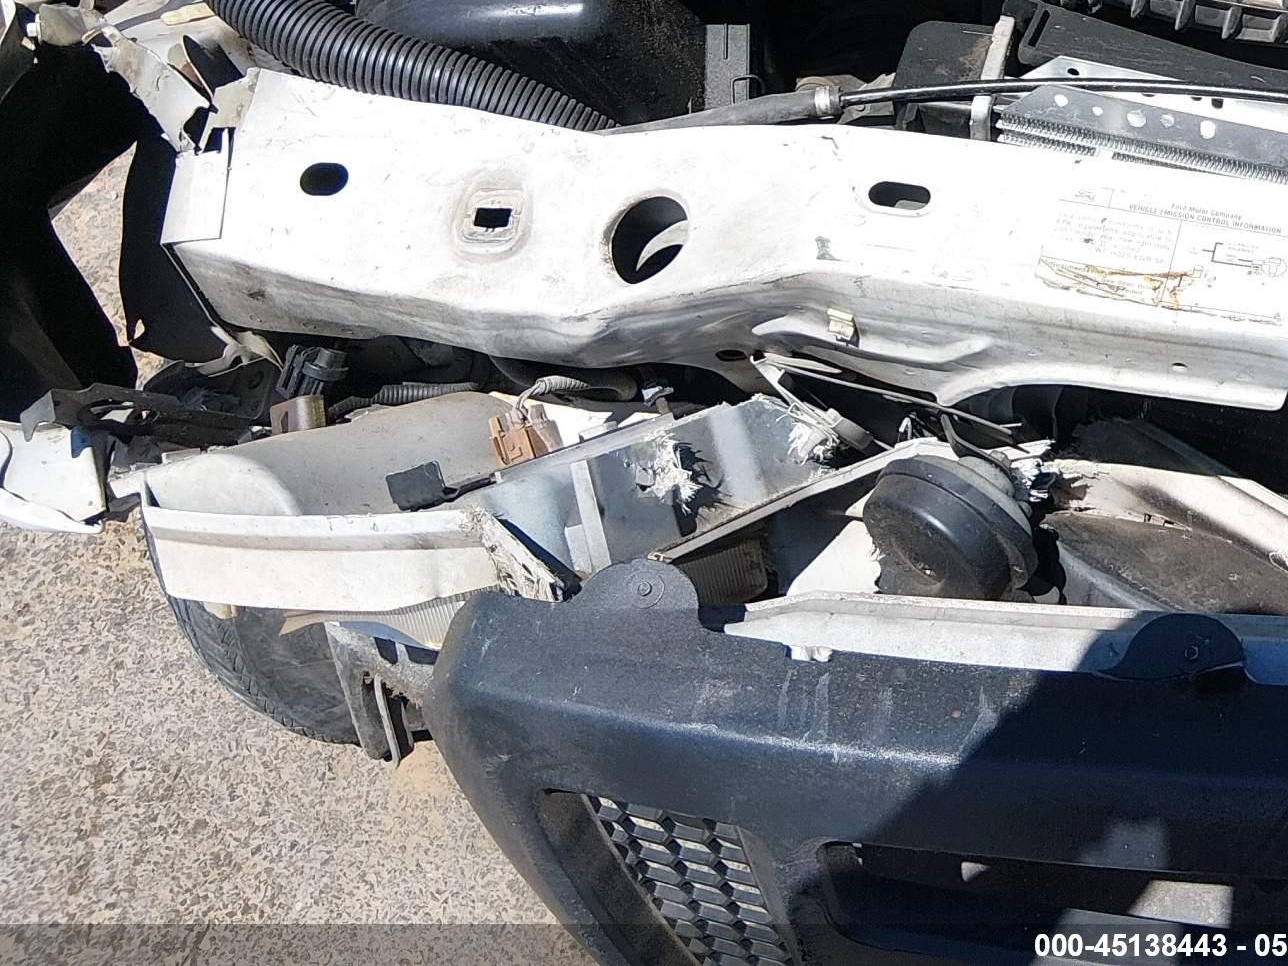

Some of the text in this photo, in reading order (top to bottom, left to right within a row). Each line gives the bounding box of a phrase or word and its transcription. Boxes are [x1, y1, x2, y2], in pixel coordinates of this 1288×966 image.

[1129, 203, 1282, 234] VEHICLE EMISSION CONTROL INFORMATION
[1210, 209, 1243, 221] Company
